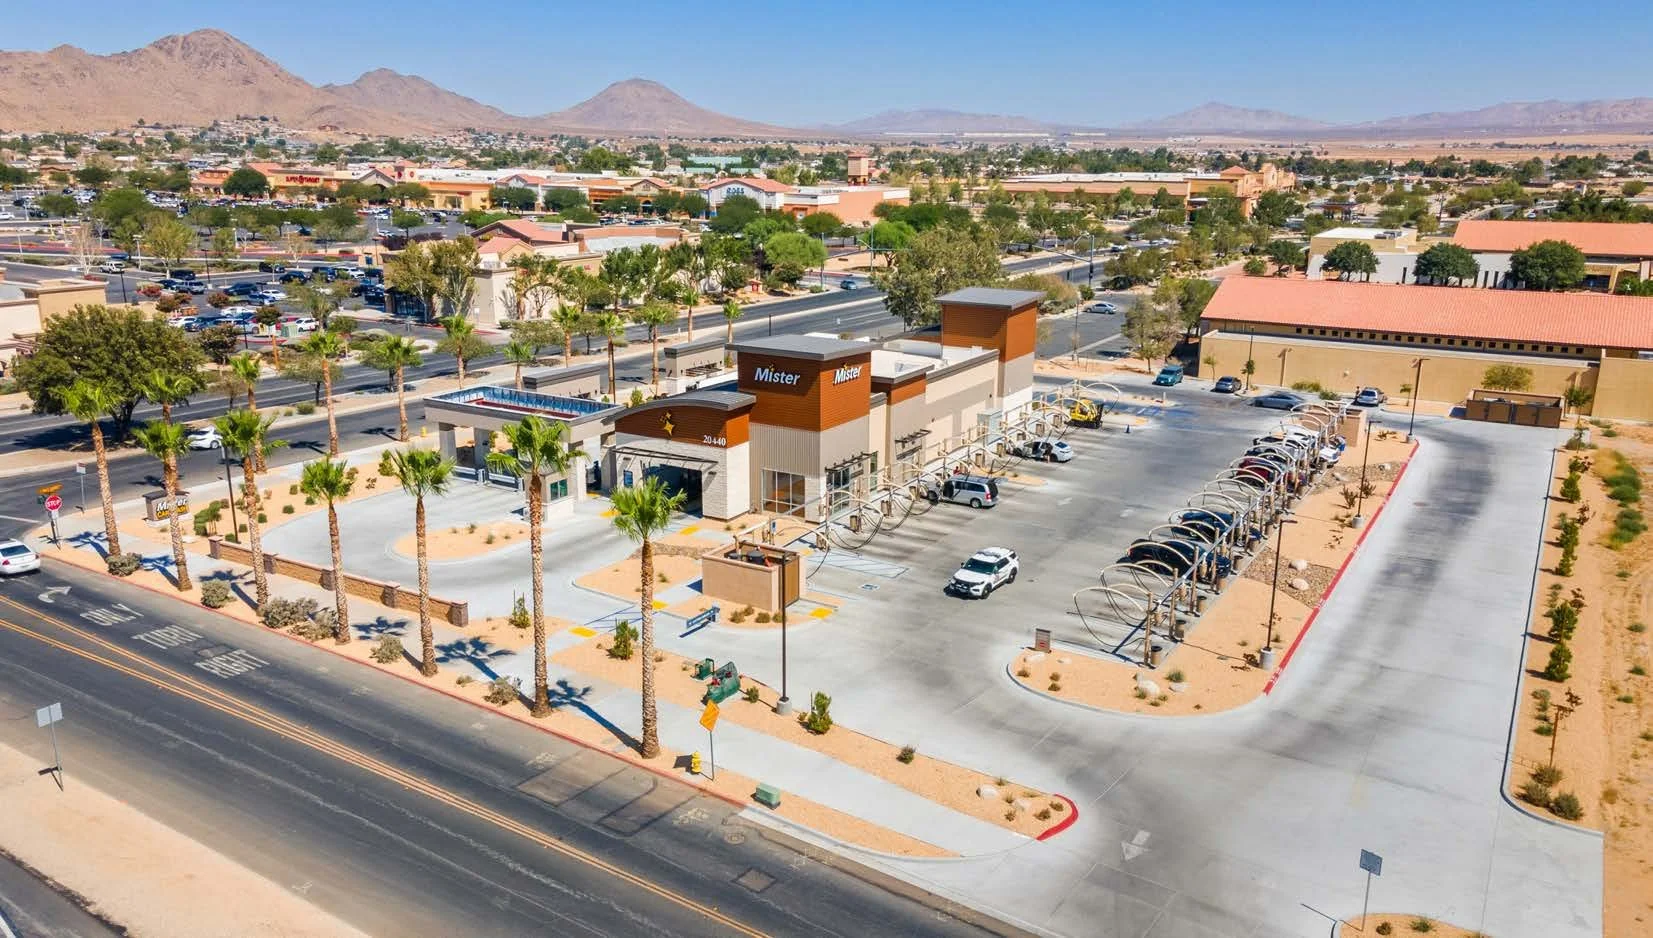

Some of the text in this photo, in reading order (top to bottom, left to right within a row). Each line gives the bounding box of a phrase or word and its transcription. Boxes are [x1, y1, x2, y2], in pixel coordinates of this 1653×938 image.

[754, 366, 801, 385] Mister
[834, 365, 862, 385] Mister
[703, 434, 727, 447] 20440
[46, 499, 61, 508] STOP
[80, 603, 144, 626] ONLY
[131, 624, 204, 649] TURN
[193, 648, 270, 679] RIGHT
